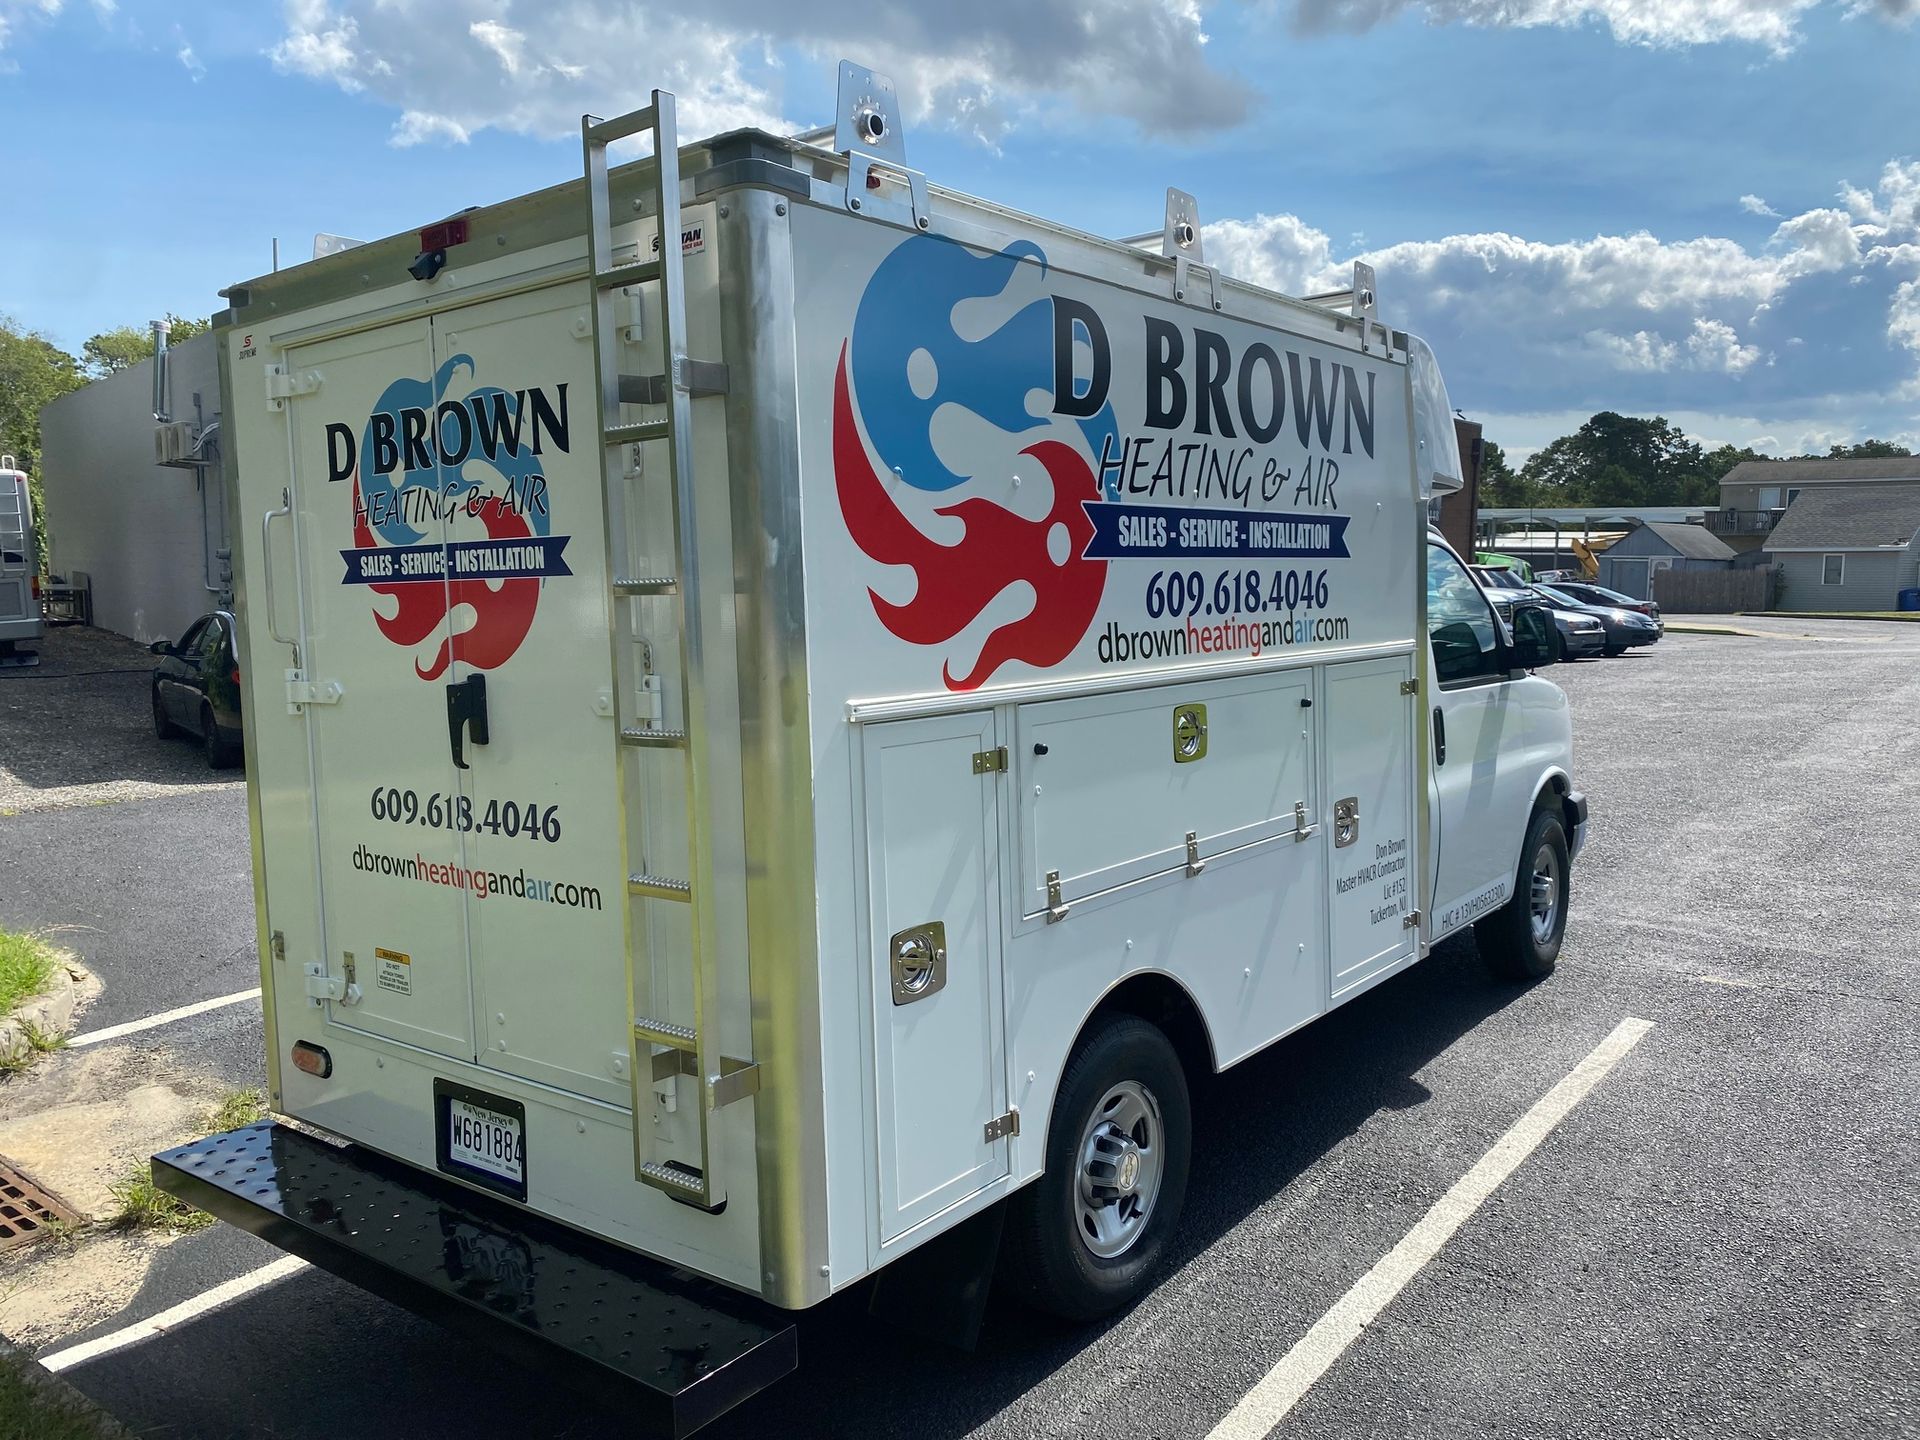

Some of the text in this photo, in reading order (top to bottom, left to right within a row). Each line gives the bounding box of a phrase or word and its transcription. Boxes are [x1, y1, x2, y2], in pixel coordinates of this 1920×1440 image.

[1051, 294, 1376, 459] D BROWN
[325, 383, 570, 482] D BROWN
[1097, 435, 1340, 510] HEATING & AIR
[353, 475, 547, 528] HEATING & AIR
[1118, 515, 1167, 548] SALES
[1179, 518, 1239, 548] SERVICE
[1249, 520, 1330, 549] INSTALLATION
[360, 554, 393, 577] SALES
[400, 552, 446, 576] SERVICE
[455, 546, 545, 572] INSTALLATION
[1146, 569, 1329, 619] 609.618.4046
[1097, 609, 1349, 663] dbrownheatingandair.com
[371, 786, 561, 843] 609.618.4046
[1376, 839, 1406, 860] Don Brown
[352, 844, 602, 910] dbrownheatingandair.com
[1336, 857, 1406, 895] Master HVACR Contractor
[1383, 877, 1406, 900] Lic #152
[1370, 895, 1407, 925] Tuckerton, NJ
[1441, 910, 1454, 930] HIC
[453, 1113, 521, 1168] W681884
[472, 1106, 508, 1127] New Jersey
